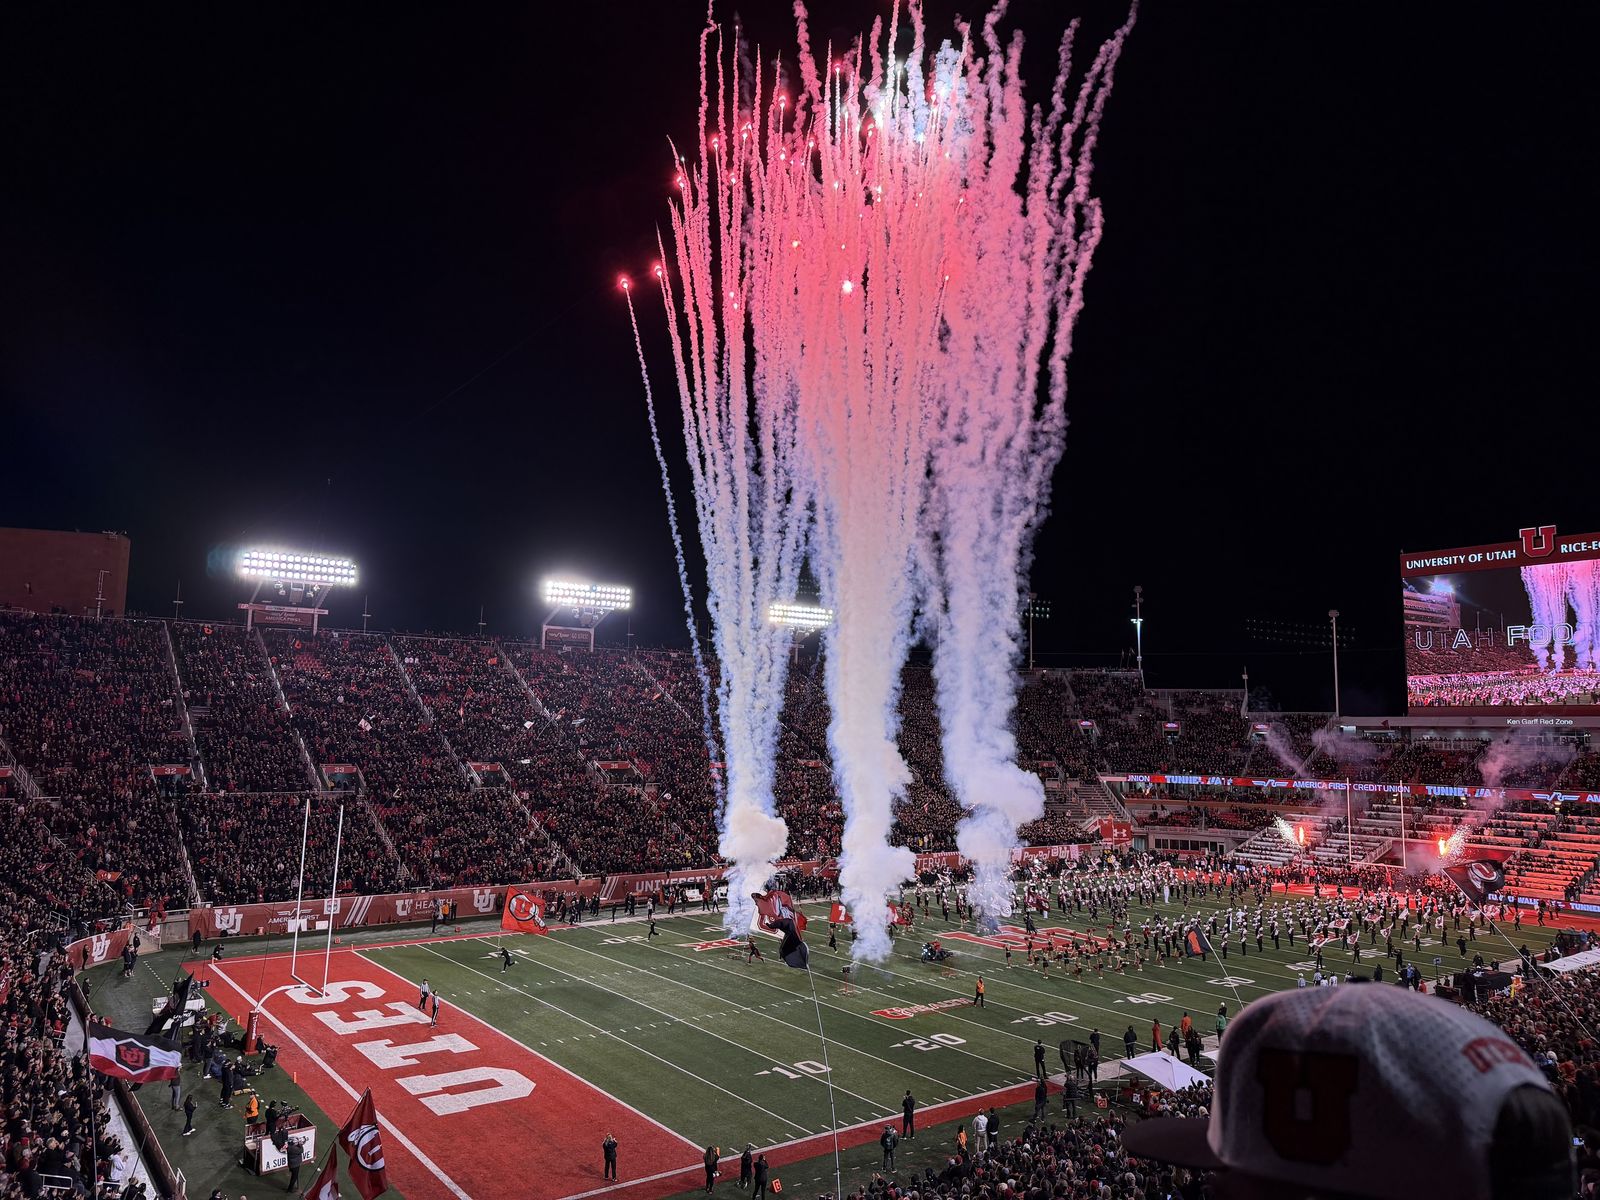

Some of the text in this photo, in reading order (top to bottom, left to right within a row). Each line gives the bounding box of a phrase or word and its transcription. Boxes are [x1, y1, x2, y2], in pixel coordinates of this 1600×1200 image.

[1518, 525, 1557, 558] U
[1406, 550, 1516, 569] UNIVERSITY OF UTAH
[1415, 627, 1494, 650] UTAH
[164, 767, 177, 775] 32
[1292, 781, 1410, 793] AMERICA FIRST CREDIT UNION
[1023, 850, 1050, 861] PayPal
[415, 898, 453, 910] HEATH
[1205, 976, 1256, 987] 50
[1126, 992, 1174, 1004] 40
[1021, 1011, 1079, 1026] 30
[902, 1033, 966, 1051] 20
[771, 1060, 832, 1079] 10
[1257, 1047, 1360, 1166] U
[265, 1157, 287, 1170] A SUB
